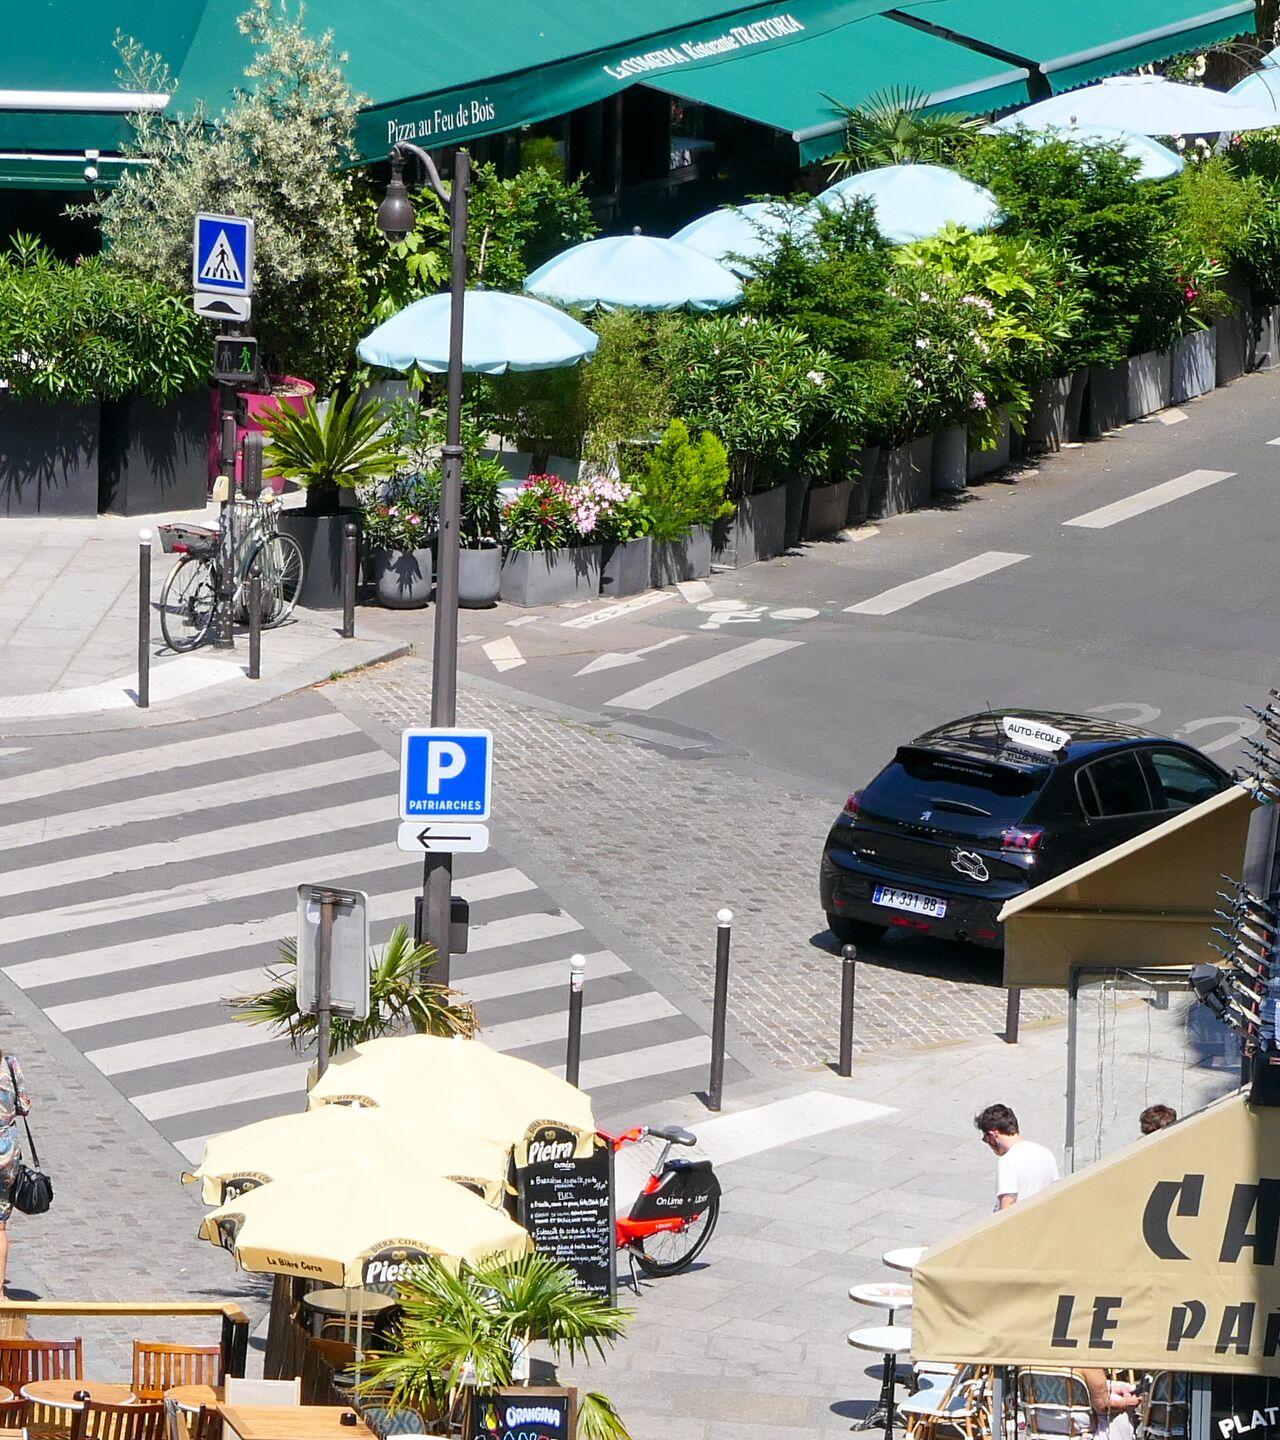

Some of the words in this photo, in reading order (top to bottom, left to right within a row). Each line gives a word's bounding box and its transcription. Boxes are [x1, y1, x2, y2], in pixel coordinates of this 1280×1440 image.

[731, 13, 805, 47] TRATTORIA
[388, 118, 416, 144] Pizza
[419, 118, 432, 137] au
[434, 109, 454, 134] Feu
[456, 104, 469, 127] de
[471, 97, 495, 125] Bois
[1007, 722, 1063, 746] AUTO-ÉCOLE
[427, 741, 466, 794] P
[409, 800, 481, 811] PATRIARCHES
[528, 1140, 574, 1165] Pietra
[1051, 1294, 1123, 1351] LE
[1218, 1406, 1280, 1440] PLAT
